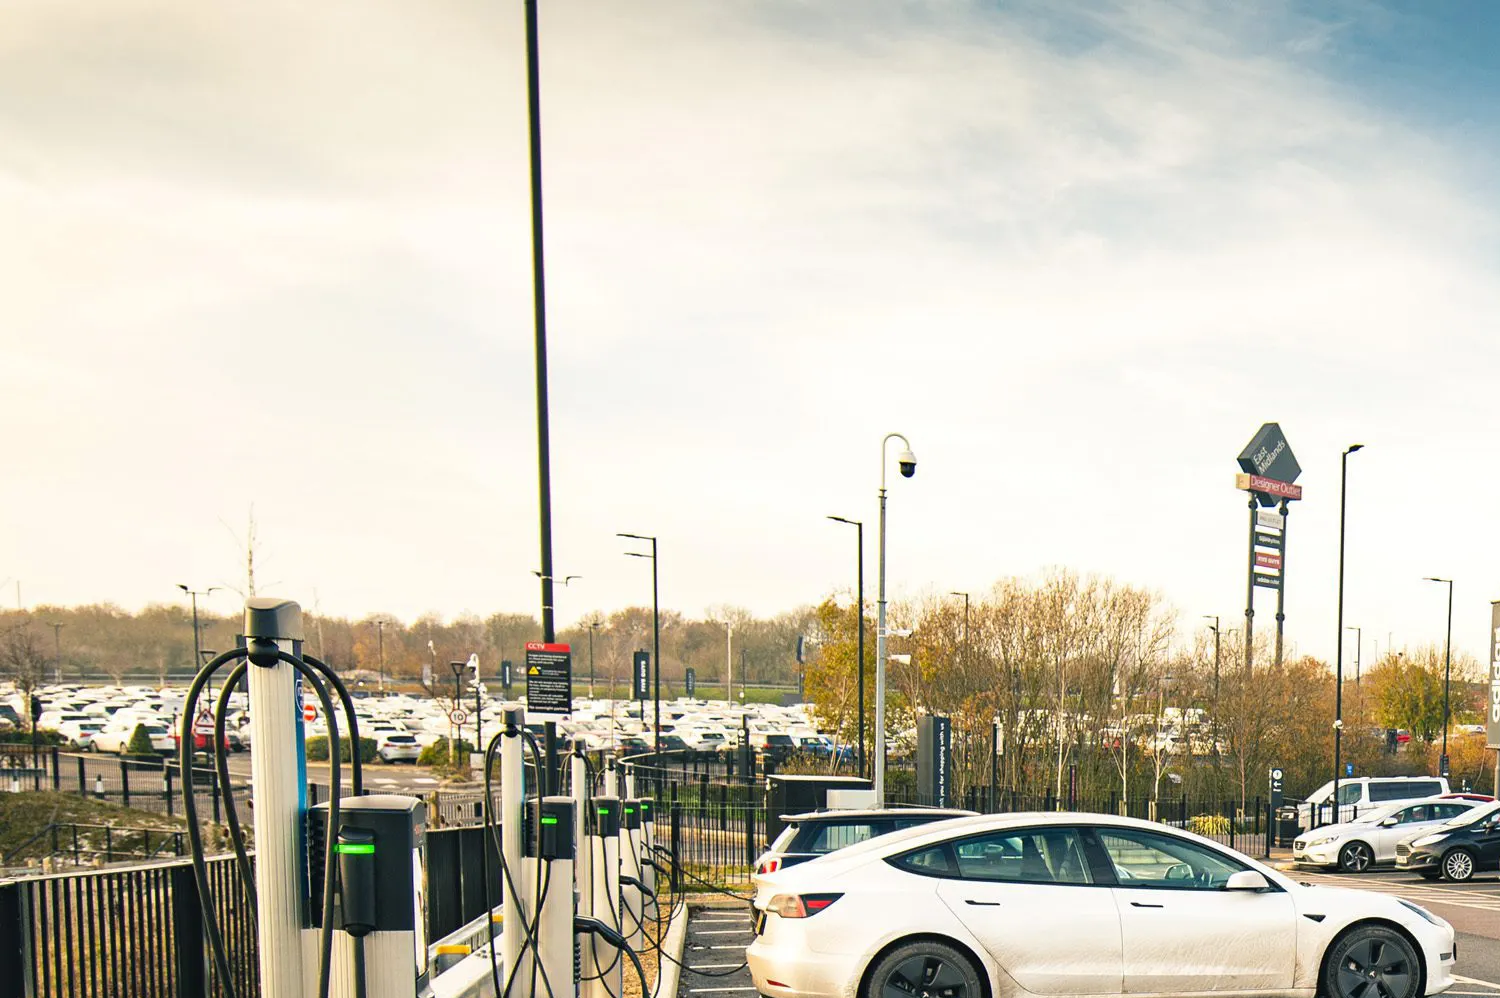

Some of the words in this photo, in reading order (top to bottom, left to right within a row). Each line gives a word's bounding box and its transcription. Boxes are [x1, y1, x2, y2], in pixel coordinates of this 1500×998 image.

[1253, 446, 1267, 464] East
[1258, 440, 1286, 473] Midlands
[1251, 475, 1280, 492] Designer
[1280, 482, 1301, 497] Outlet
[528, 642, 545, 650] CCTV
